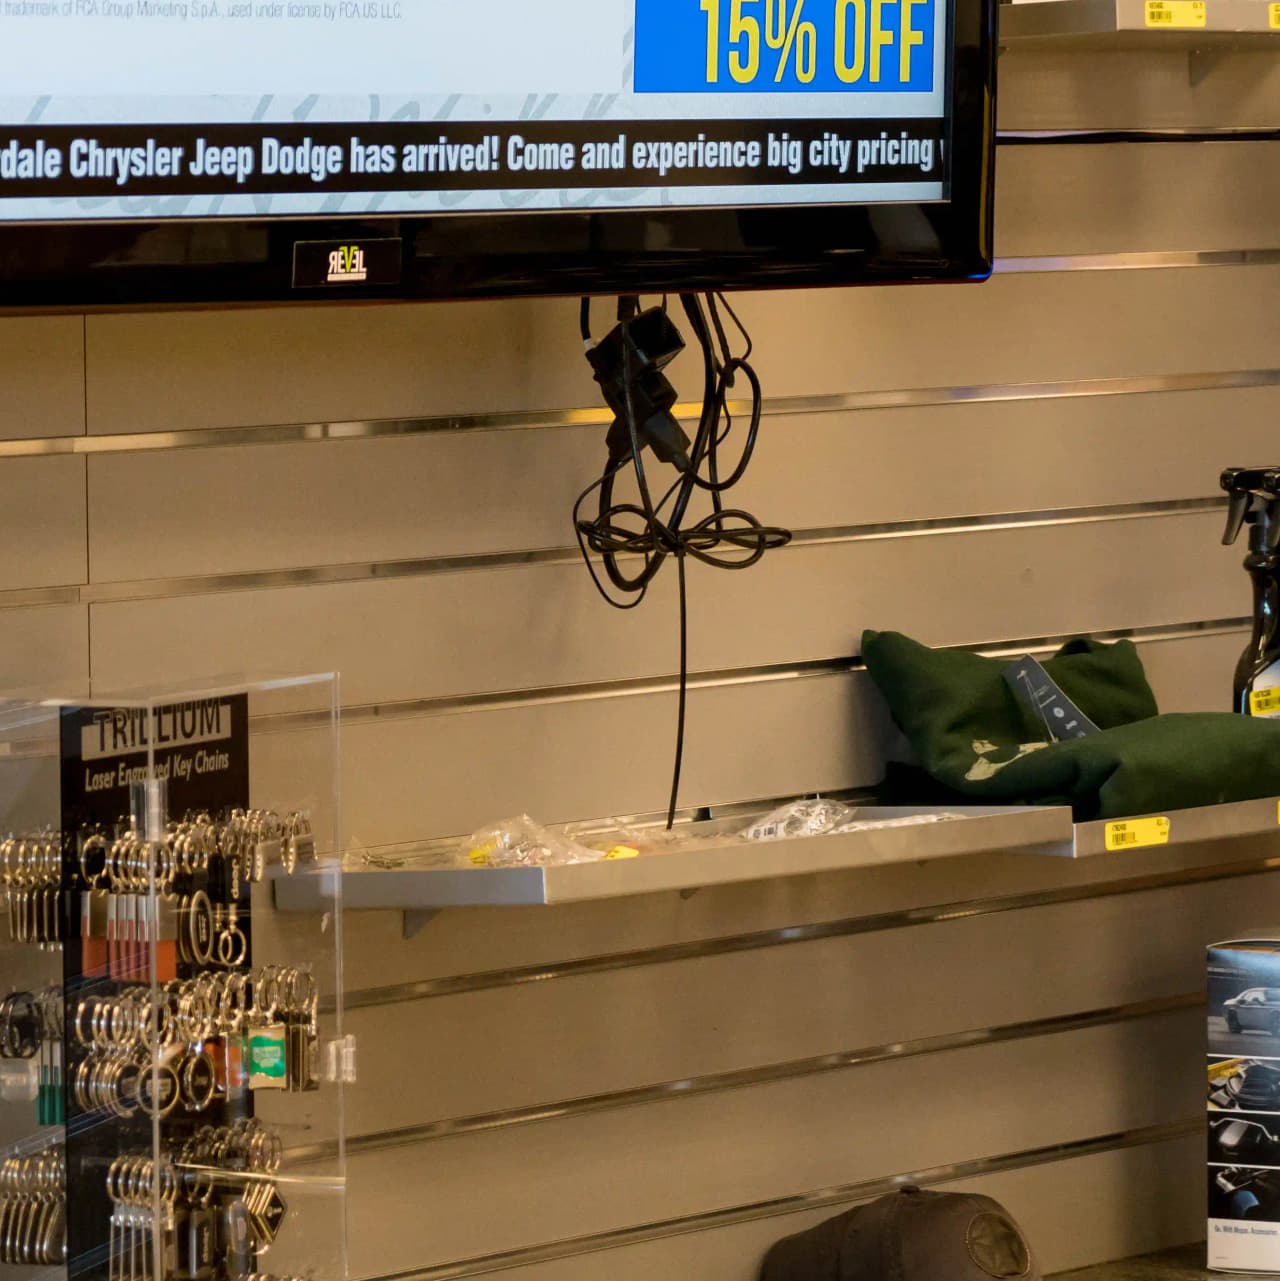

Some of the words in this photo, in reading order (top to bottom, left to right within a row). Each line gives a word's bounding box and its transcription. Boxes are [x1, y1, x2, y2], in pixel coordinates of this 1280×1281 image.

[69, 138, 183, 185] Chrysler
[190, 138, 253, 183] Jeep
[262, 136, 343, 181] Dodge
[350, 136, 395, 173] has
[402, 134, 500, 172] arrived!
[507, 135, 574, 171] Come
[581, 133, 626, 170] and
[632, 133, 761, 176] experience
[767, 132, 803, 175] big
[809, 132, 852, 173] city
[857, 131, 934, 173] pricing
[85, 768, 115, 793] Laser
[173, 754, 192, 781] Key
[195, 750, 229, 773] Chains
